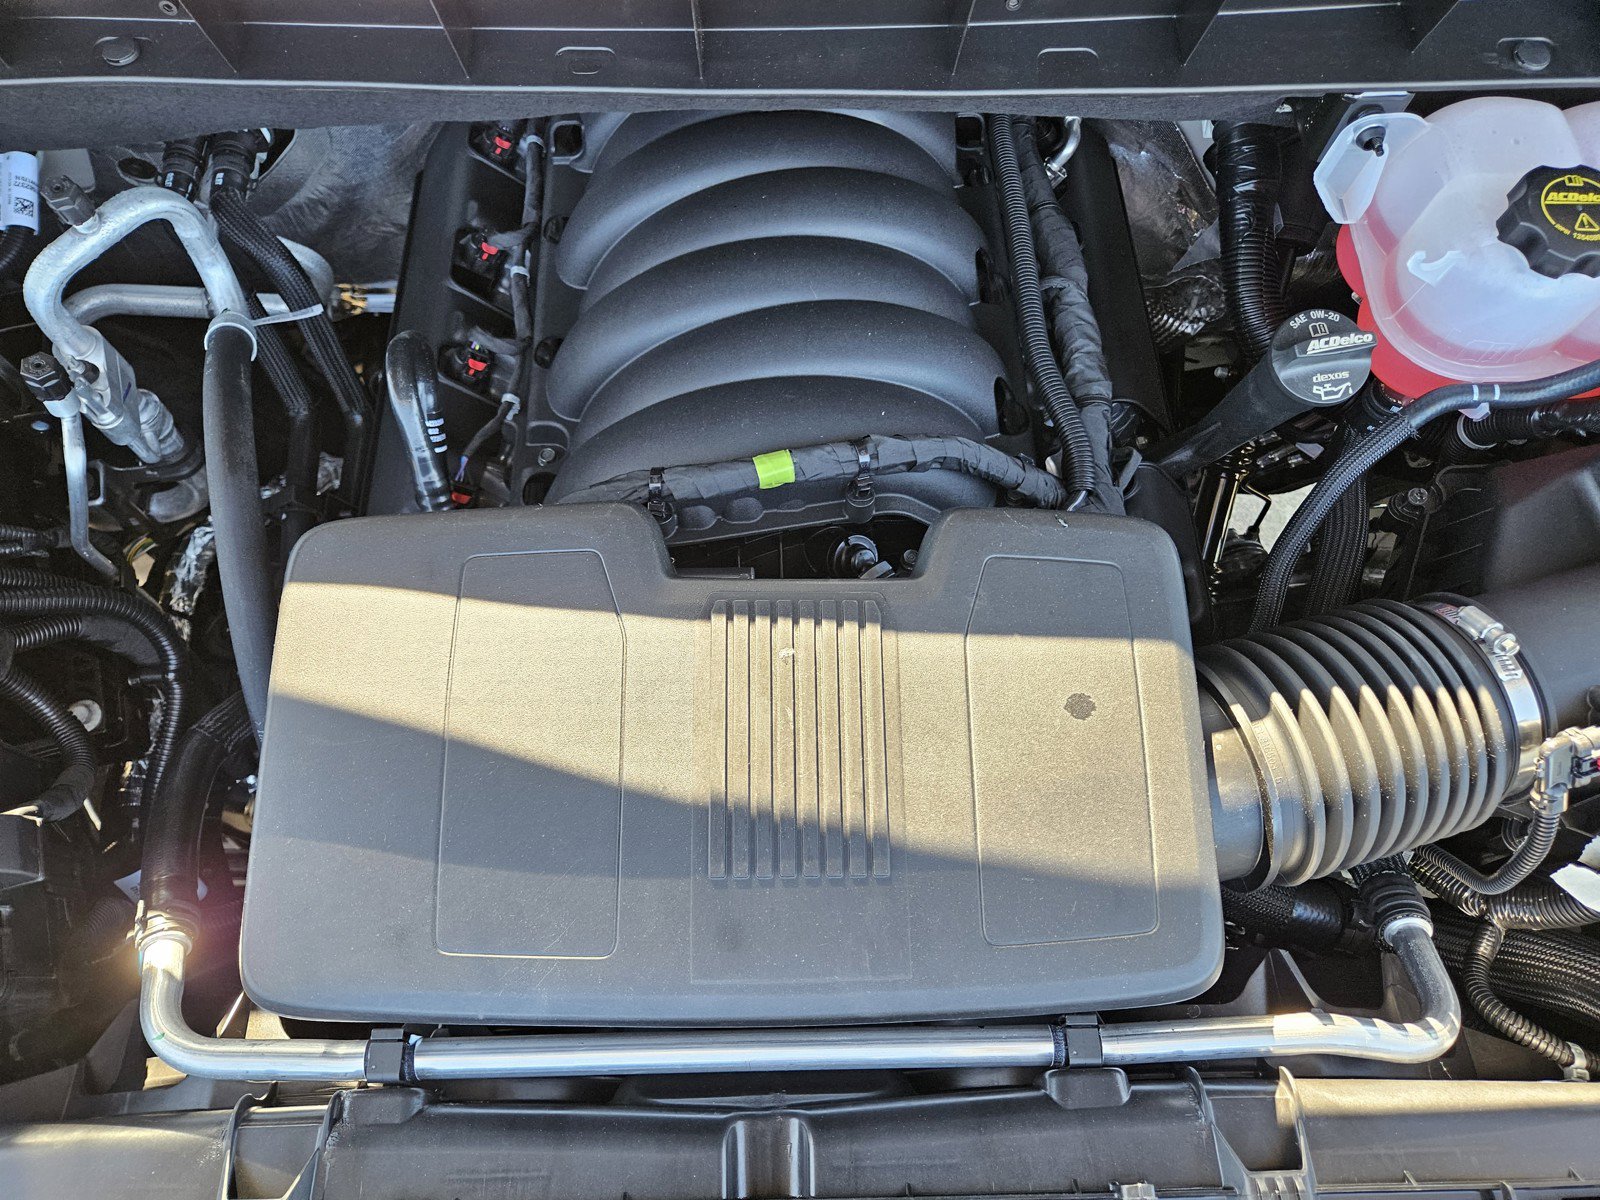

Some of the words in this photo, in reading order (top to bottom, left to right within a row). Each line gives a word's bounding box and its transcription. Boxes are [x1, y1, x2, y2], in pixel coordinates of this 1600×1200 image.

[1290, 313, 1307, 329] SAE
[1310, 310, 1340, 322] 0W-20
[1307, 333, 1373, 352] ACDelco
[1312, 371, 1350, 383] dexos
